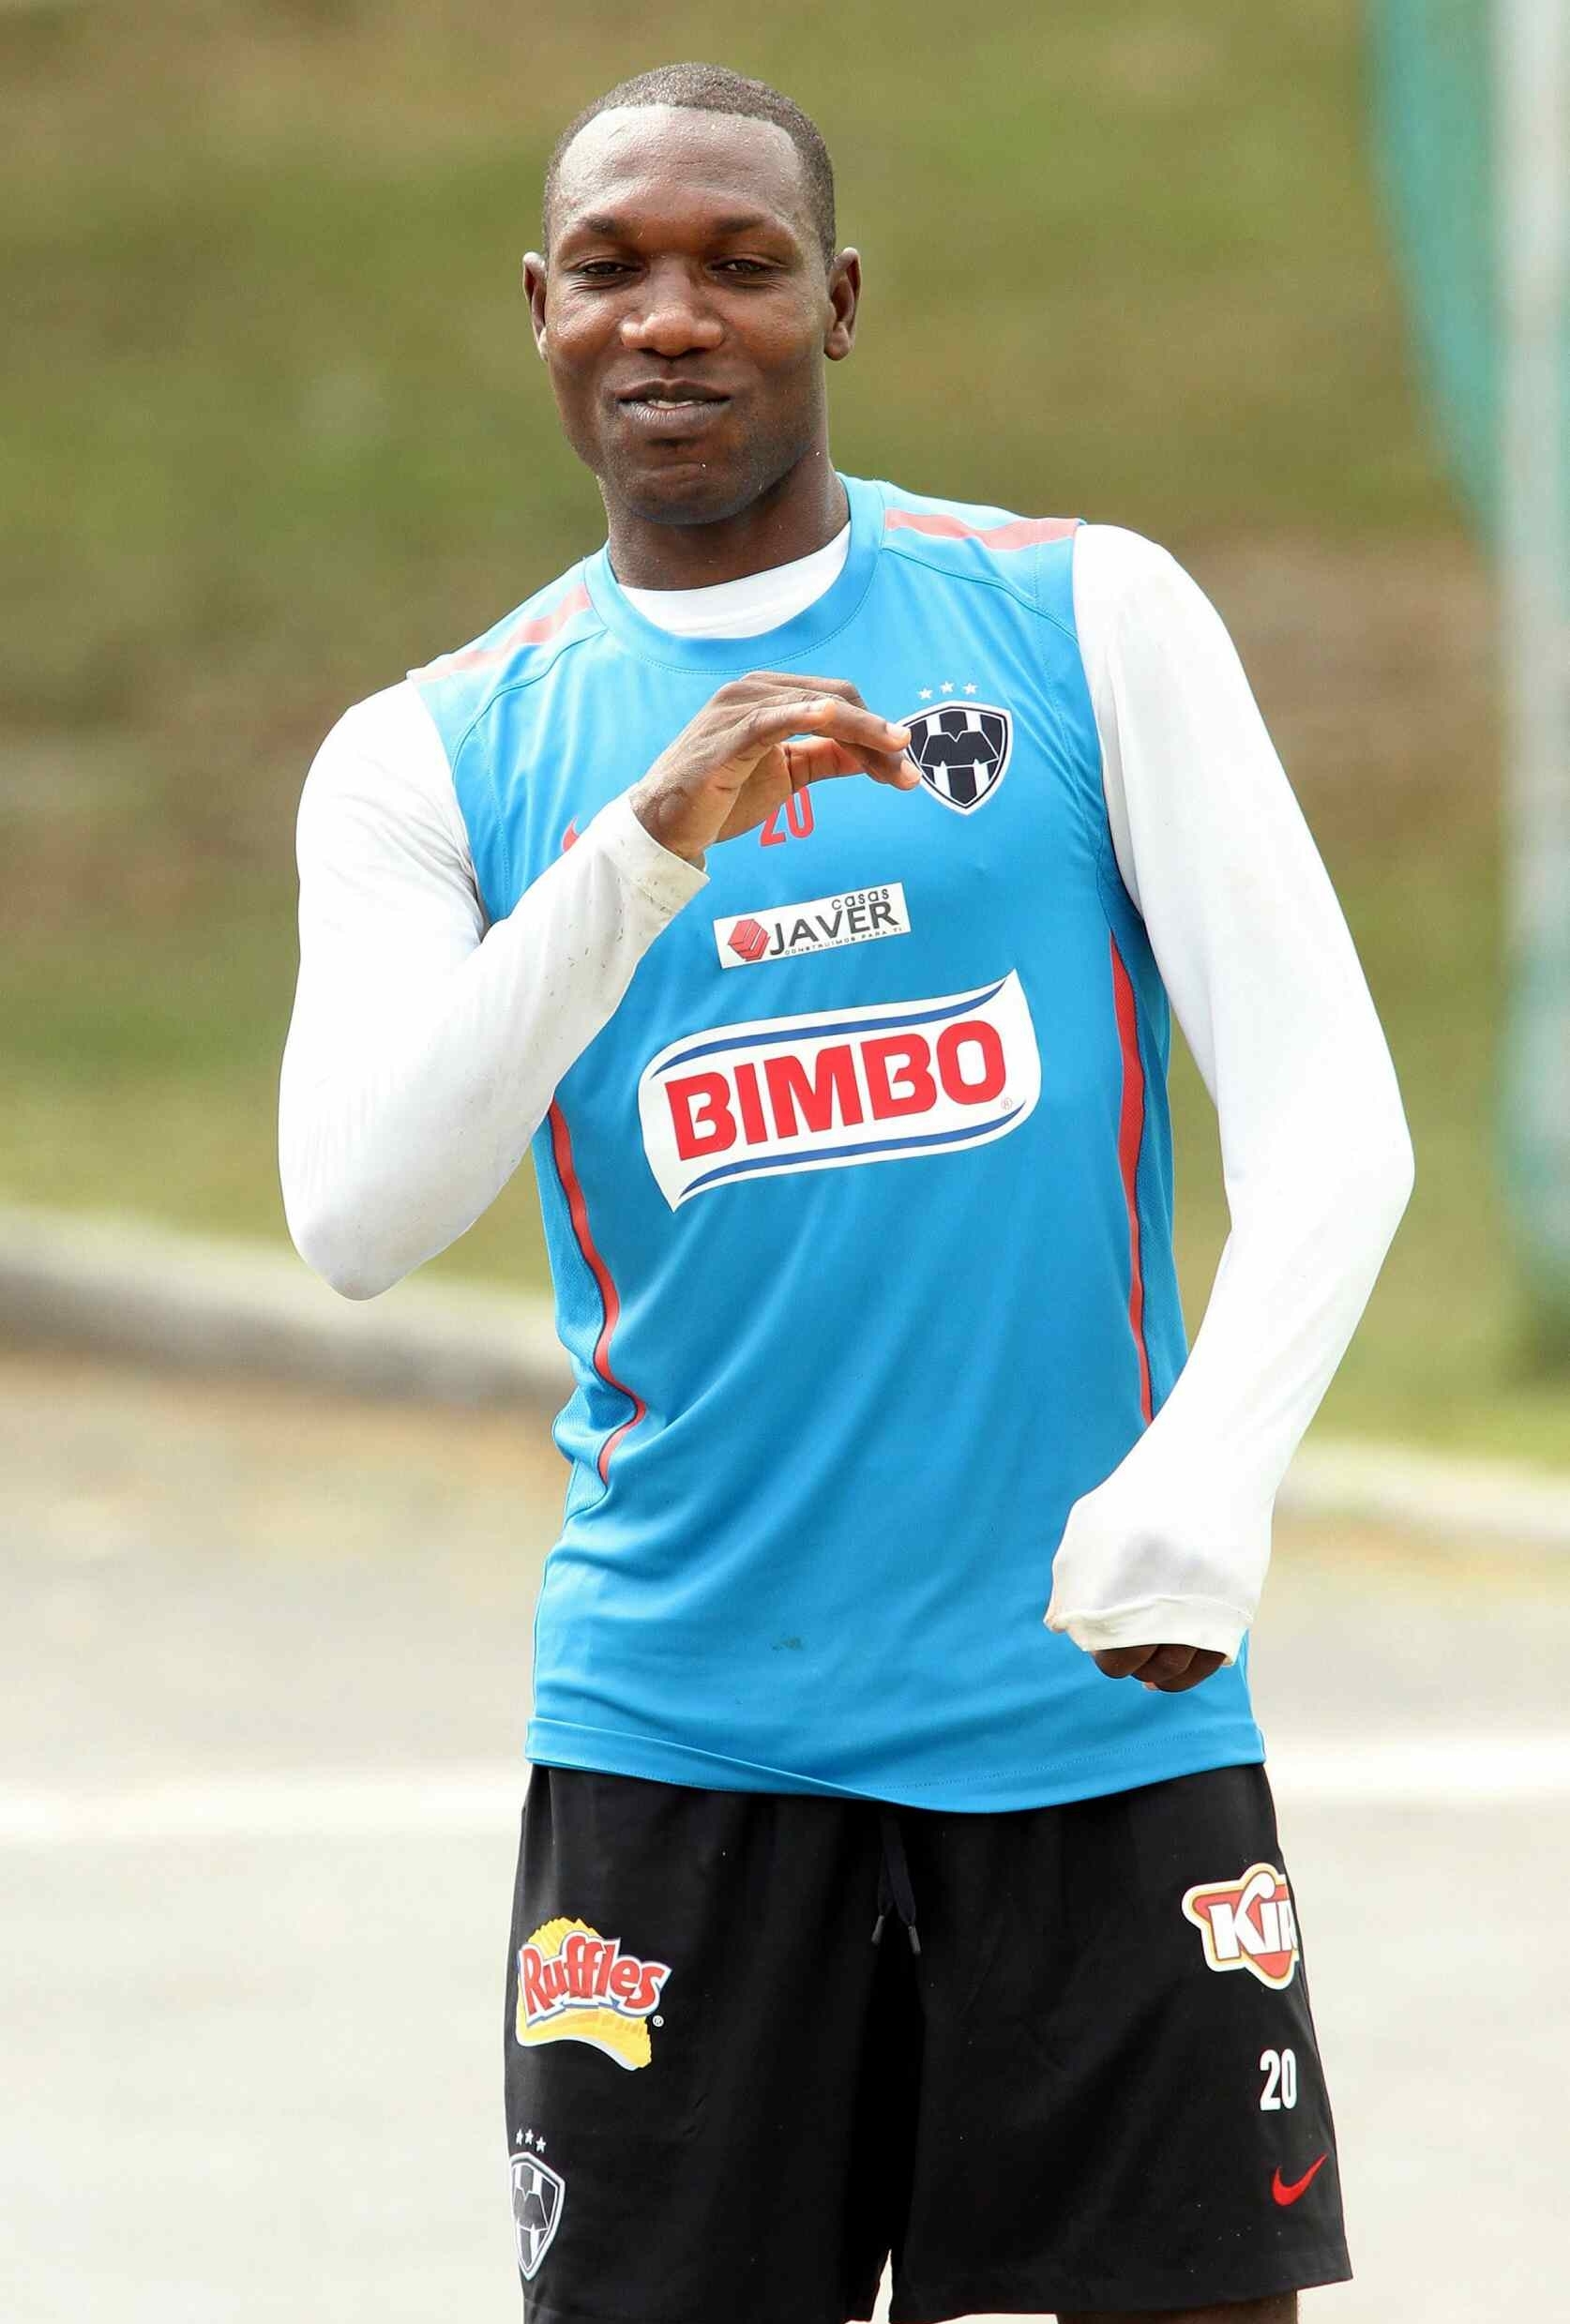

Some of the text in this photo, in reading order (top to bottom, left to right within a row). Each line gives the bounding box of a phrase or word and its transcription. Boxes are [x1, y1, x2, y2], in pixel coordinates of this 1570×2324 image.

[760, 785, 815, 847] 20
[769, 901, 900, 956] JAVER
[831, 888, 889, 911] casas
[665, 1019, 1006, 1161] BIMBO
[521, 1933, 668, 2017] Ruffles
[1260, 2048, 1297, 2110] 20
